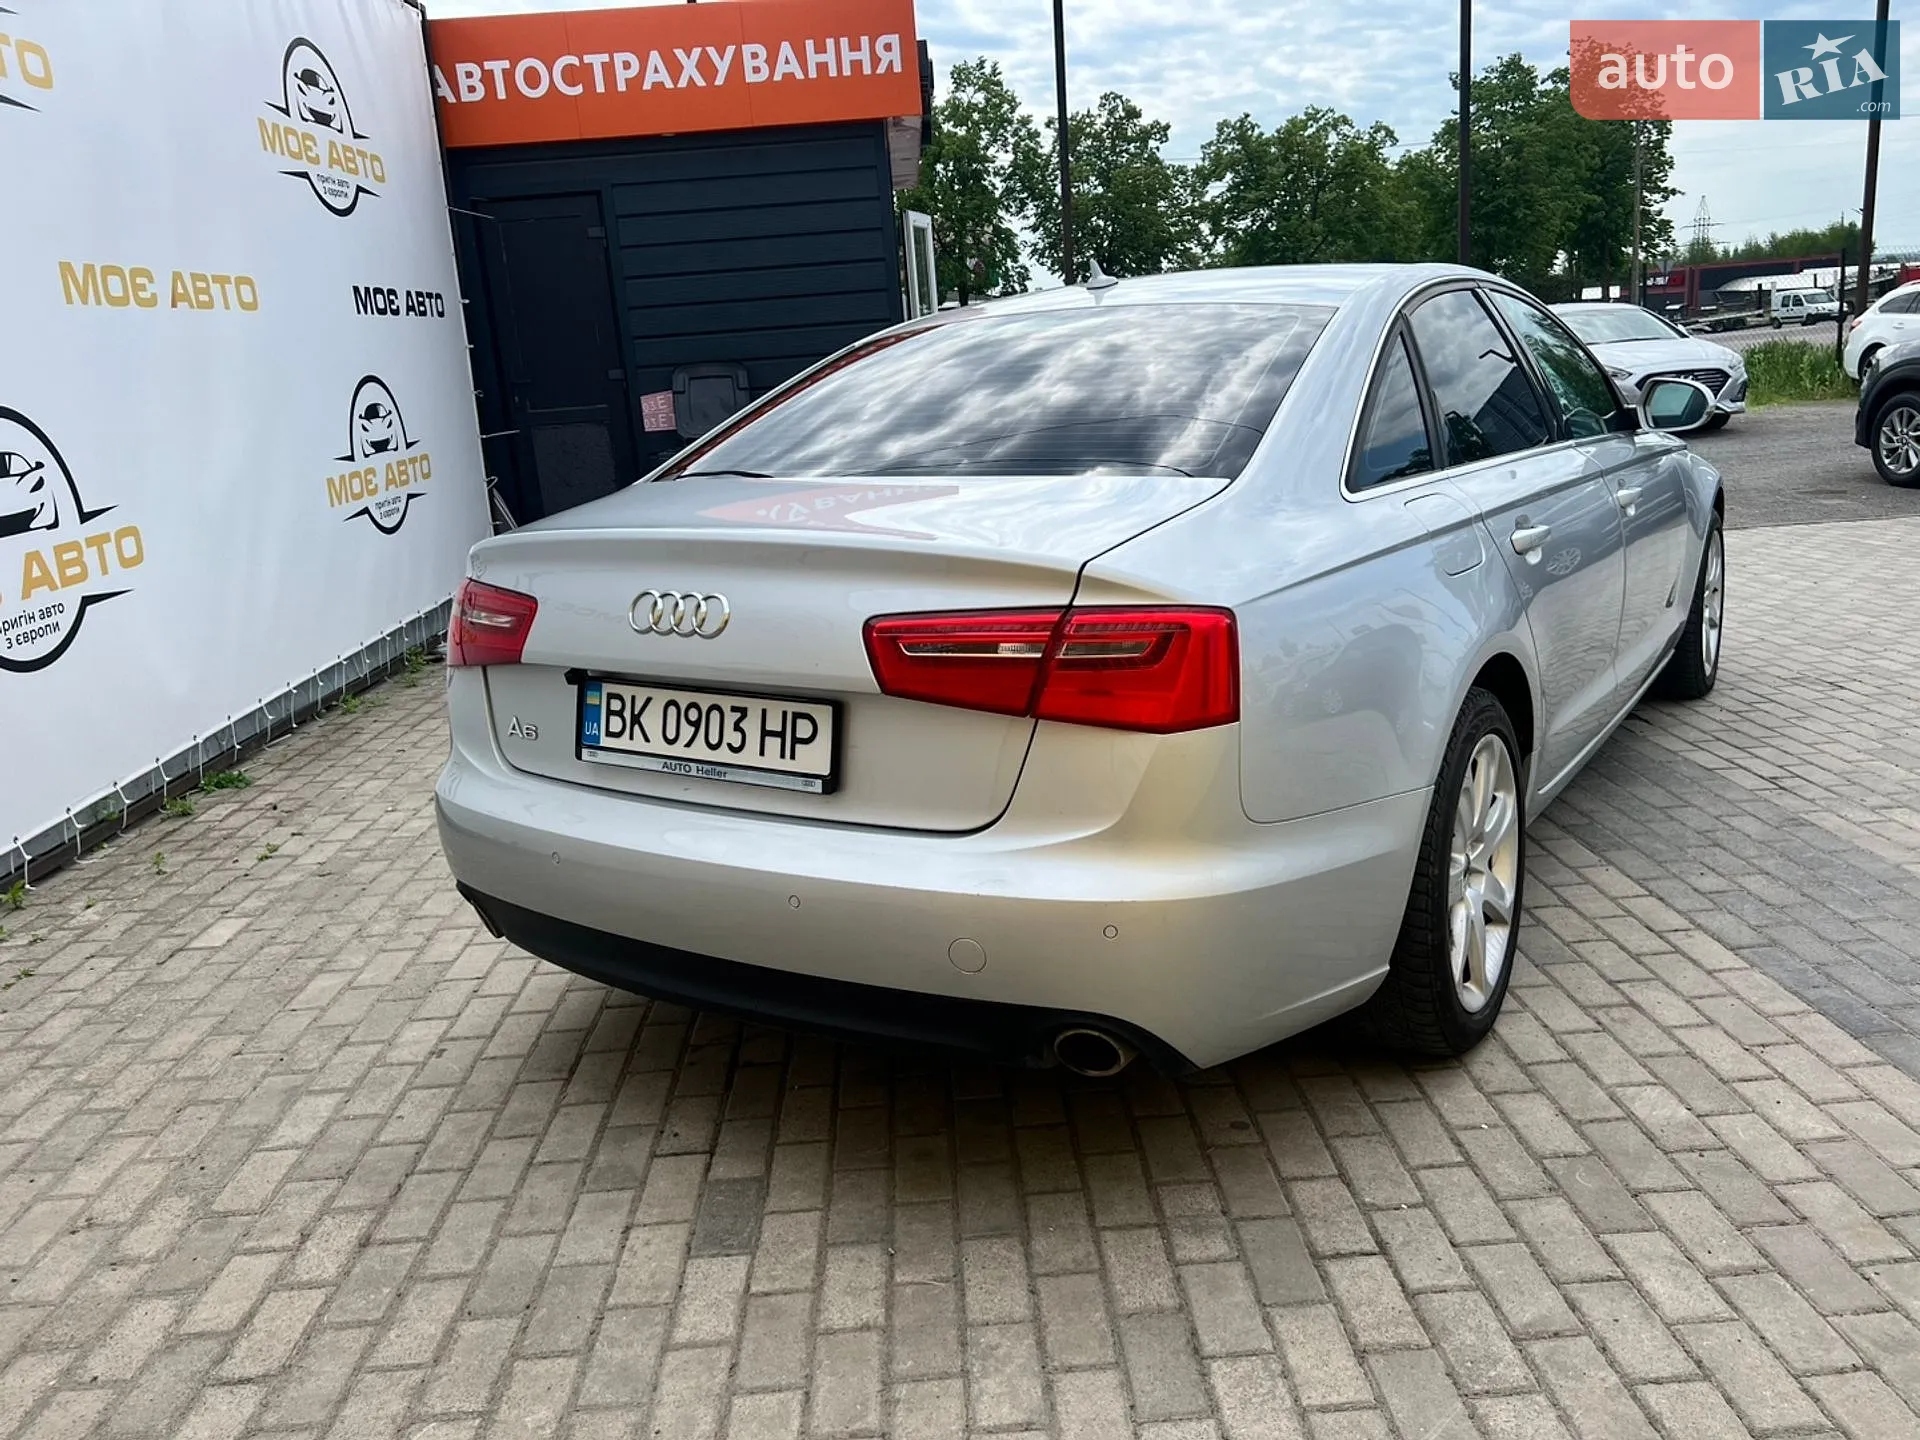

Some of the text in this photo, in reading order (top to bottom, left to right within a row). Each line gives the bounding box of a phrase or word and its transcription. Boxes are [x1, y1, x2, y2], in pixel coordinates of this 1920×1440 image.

[434, 33, 902, 104] АВТОСТРАХУВАННЯ
[257, 117, 386, 184] МОЄ АВТО
[58, 261, 259, 312] МОЄ АВТО
[352, 285, 445, 318] МОЄ АВТО
[326, 453, 432, 507] МОЄ АВТО
[22, 526, 145, 601] АВТО
[0, 602, 65, 636] ригін авто
[6, 621, 61, 649] з європи
[507, 715, 539, 740] A6
[584, 721, 599, 737] UA
[605, 692, 819, 761] BK 0903 HP
[662, 761, 728, 779] AUTO Heller
